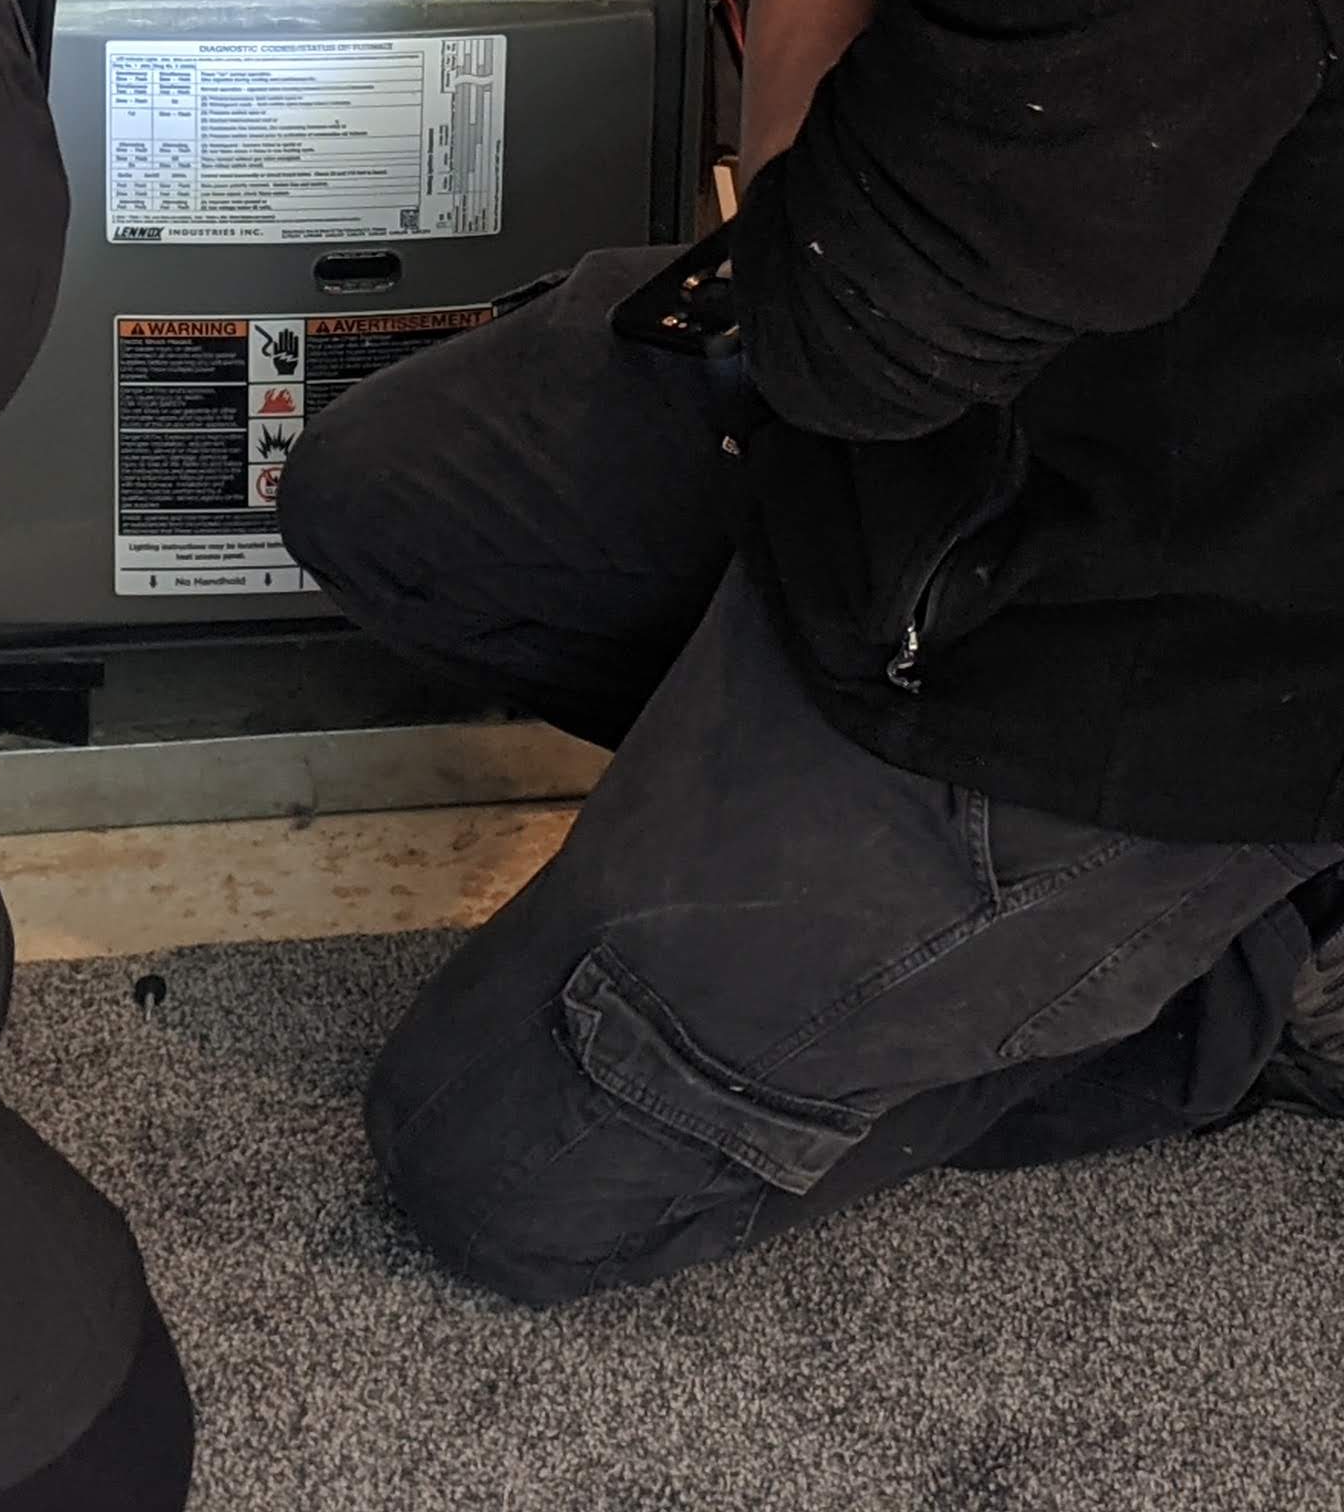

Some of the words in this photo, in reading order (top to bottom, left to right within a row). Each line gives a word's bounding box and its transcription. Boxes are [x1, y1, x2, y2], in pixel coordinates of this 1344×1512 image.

[199, 45, 257, 53] DIAGNOSTIC
[112, 226, 165, 241] LENNOX
[168, 228, 236, 237] INDUSTRIES
[240, 228, 264, 237] INC.
[333, 312, 483, 333] AVERTISSEMENT
[147, 322, 237, 335] WARNING
[162, 542, 205, 550] instructions
[175, 578, 191, 586] No
[194, 576, 246, 586] Handhold
